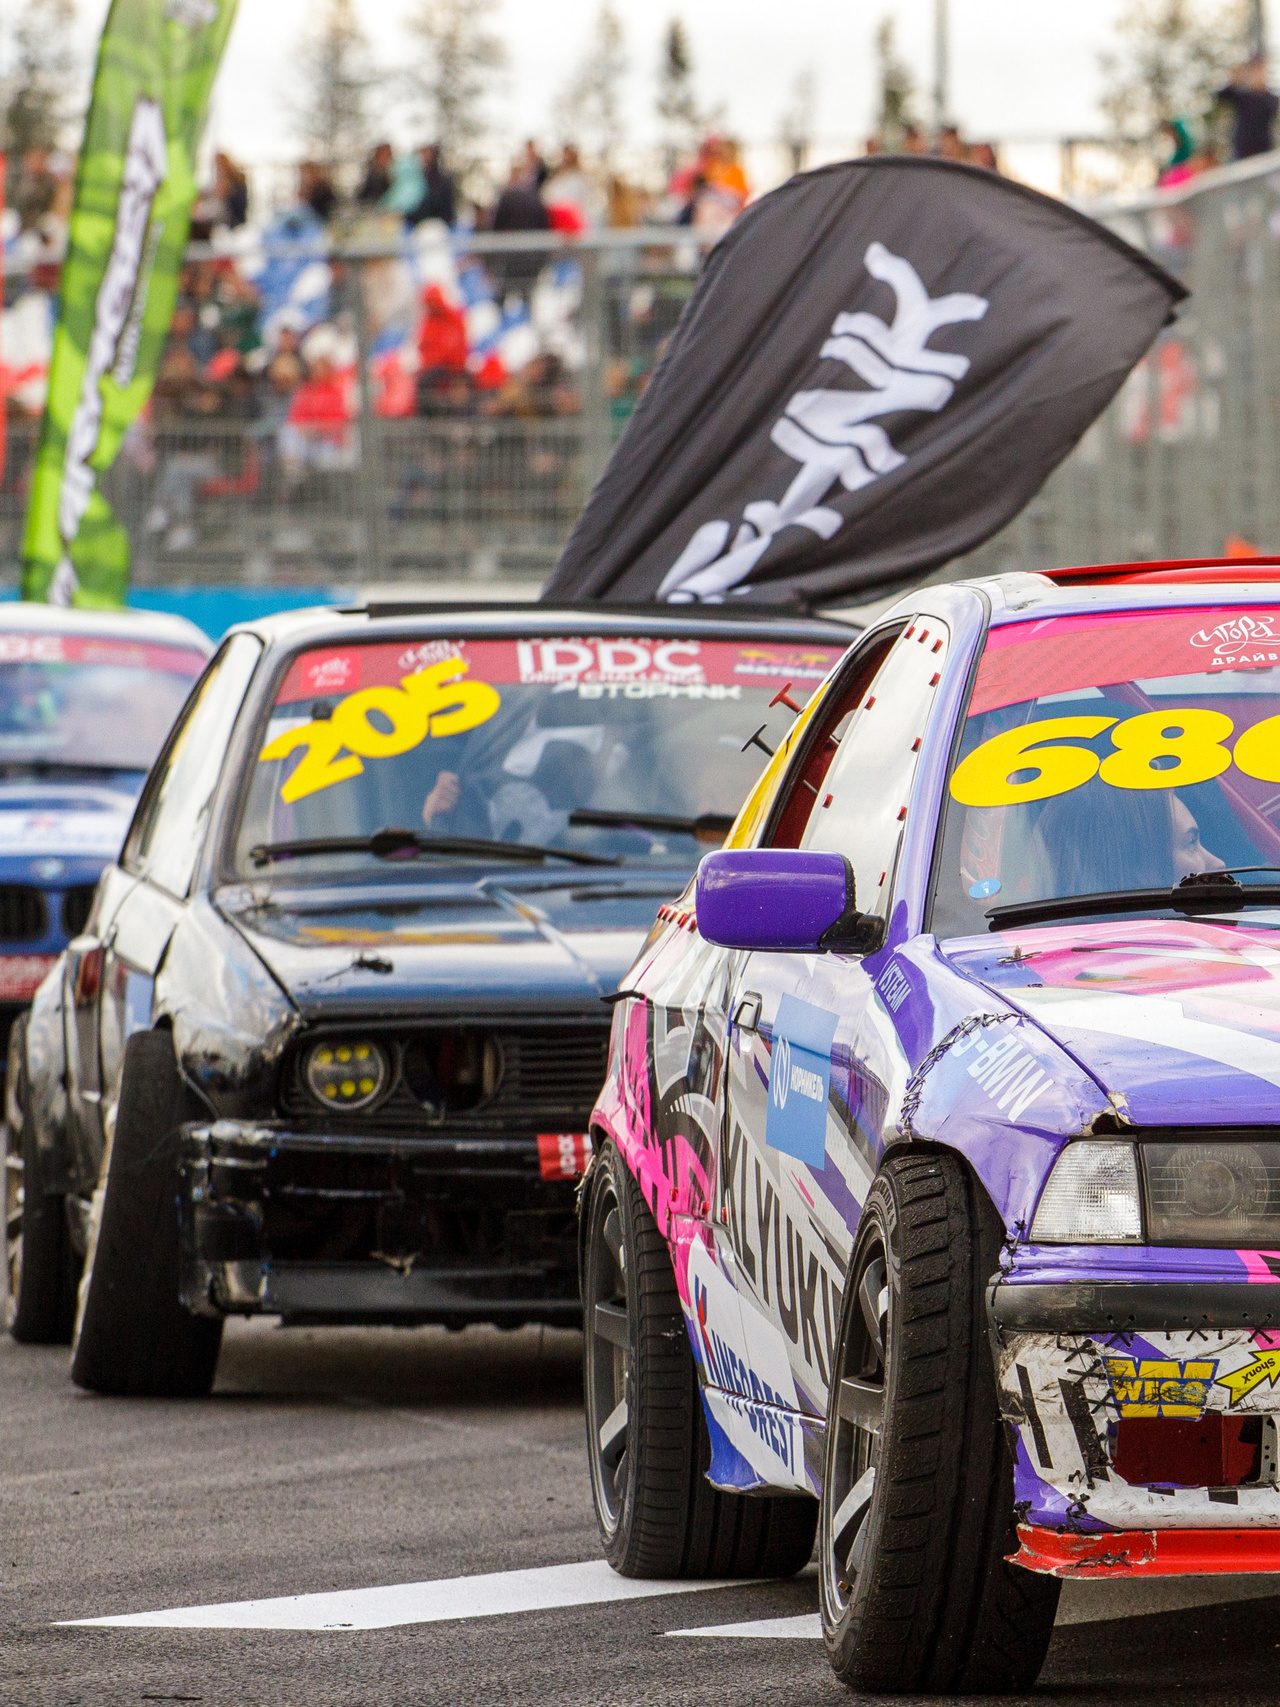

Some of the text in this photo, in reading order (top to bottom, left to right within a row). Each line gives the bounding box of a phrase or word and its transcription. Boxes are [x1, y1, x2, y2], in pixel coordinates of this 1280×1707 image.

[516, 642, 703, 674] IDDC
[1210, 652, 1279, 667] ДРАЙВ
[260, 659, 499, 801] 205
[878, 960, 913, 1013] VSTEAM
